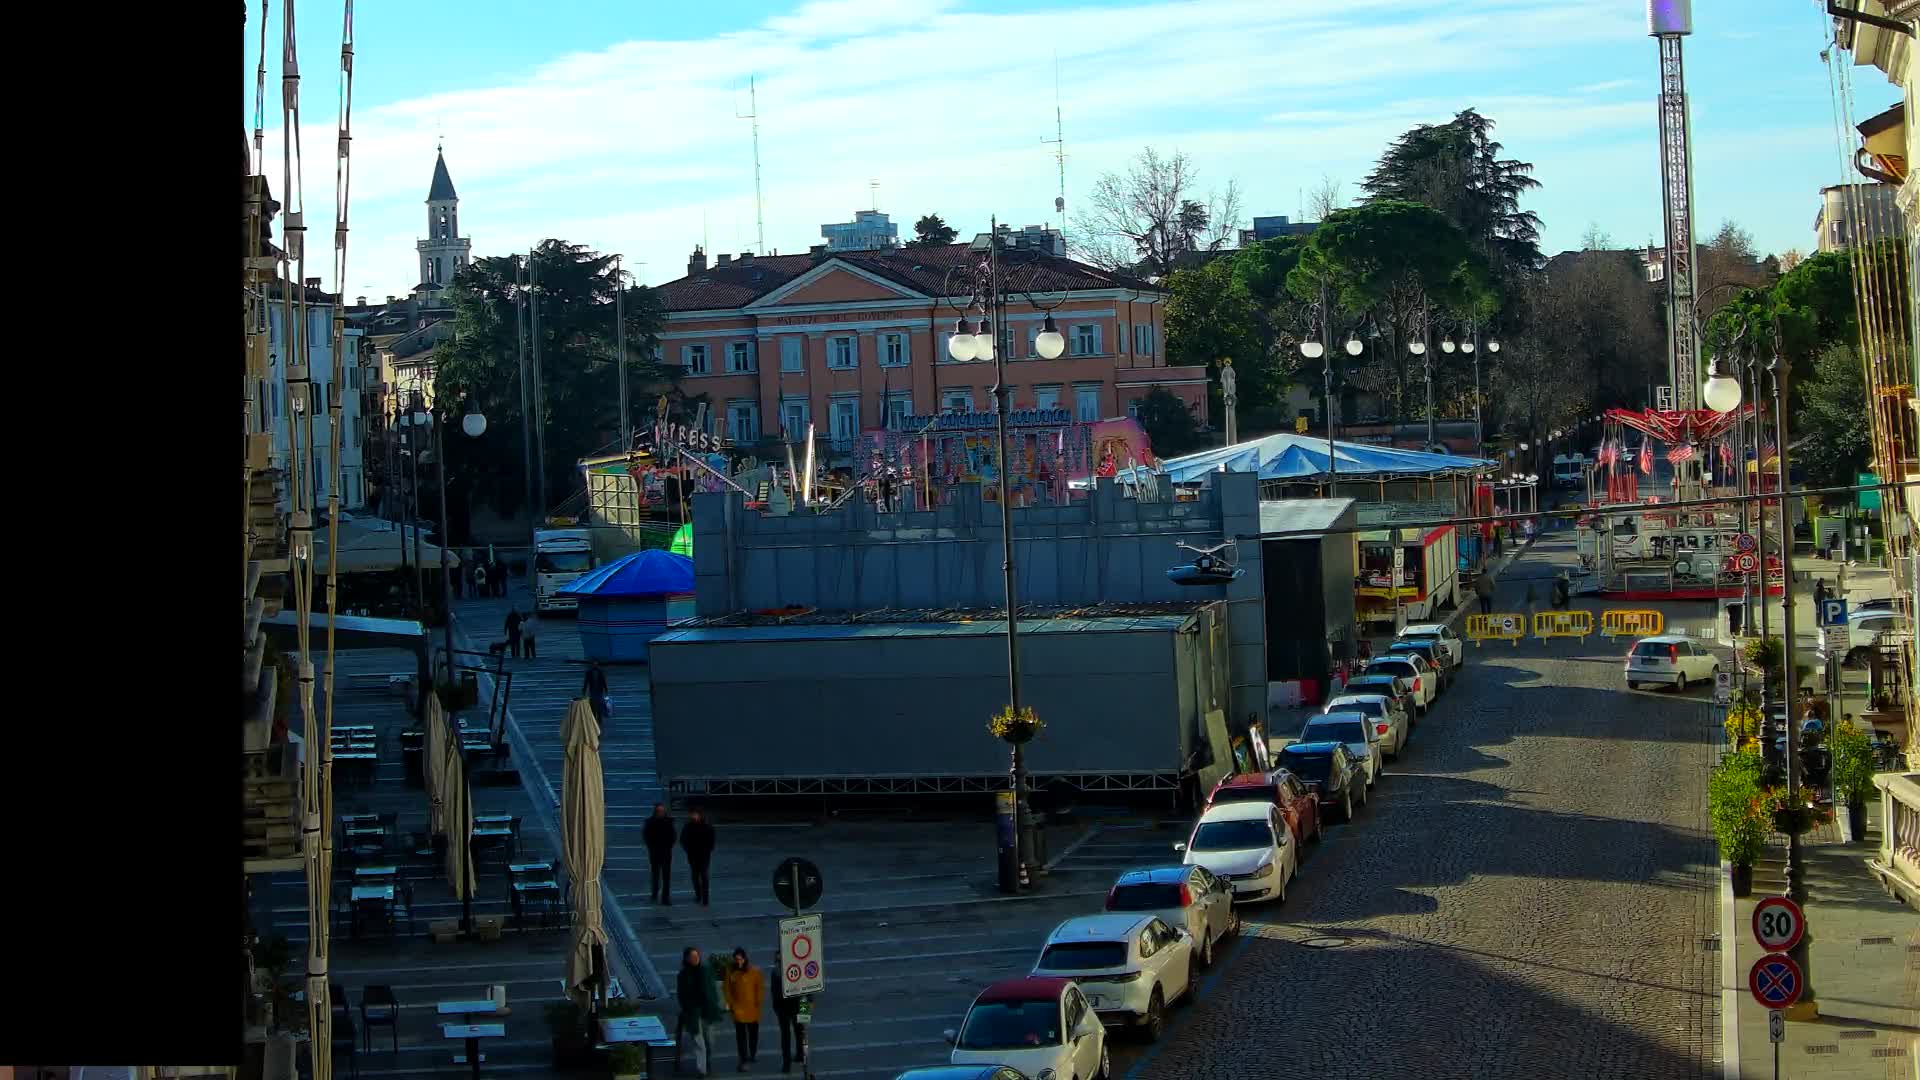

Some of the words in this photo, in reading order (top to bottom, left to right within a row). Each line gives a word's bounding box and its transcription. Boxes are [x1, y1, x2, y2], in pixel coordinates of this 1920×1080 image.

[655, 422, 721, 452] PRESS
[1742, 558, 1752, 567] 20
[1827, 602, 1842, 622] P
[1762, 912, 1791, 937] 30
